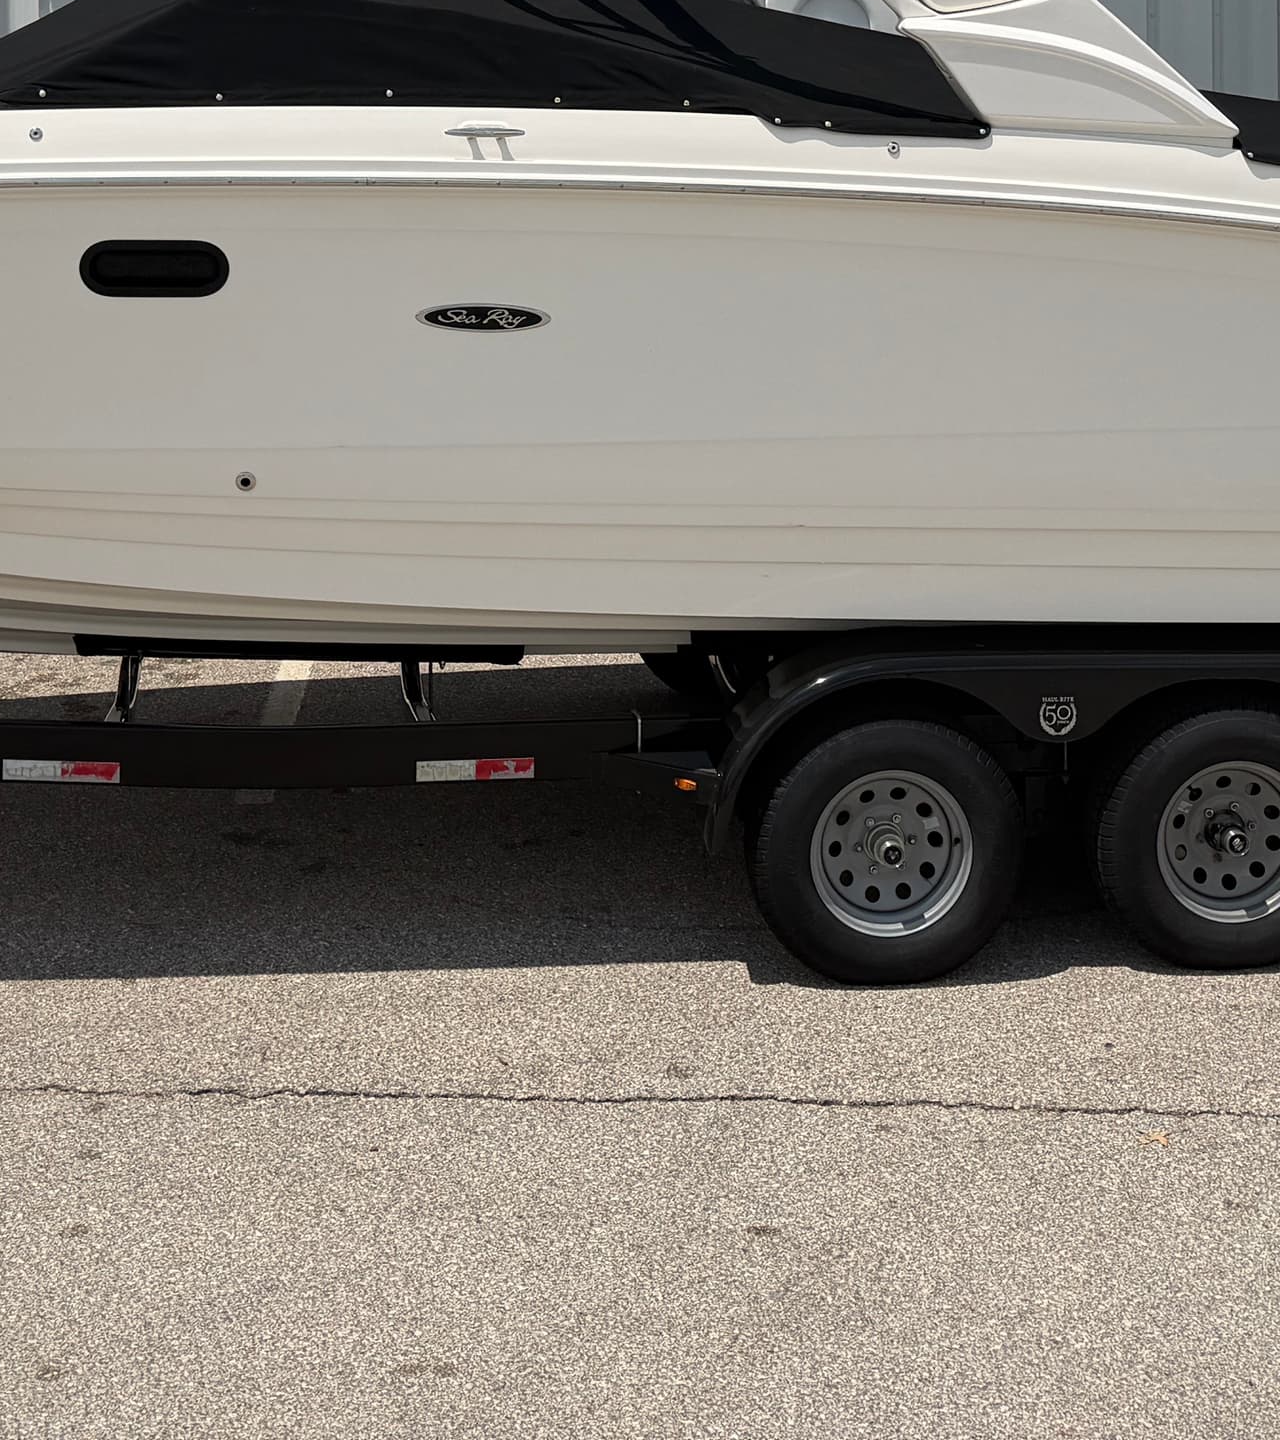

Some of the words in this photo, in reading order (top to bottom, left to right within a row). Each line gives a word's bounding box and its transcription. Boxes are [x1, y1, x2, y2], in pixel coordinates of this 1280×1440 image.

[437, 309, 481, 324] Sea
[482, 309, 527, 328] Ray
[1045, 704, 1071, 726] 50
